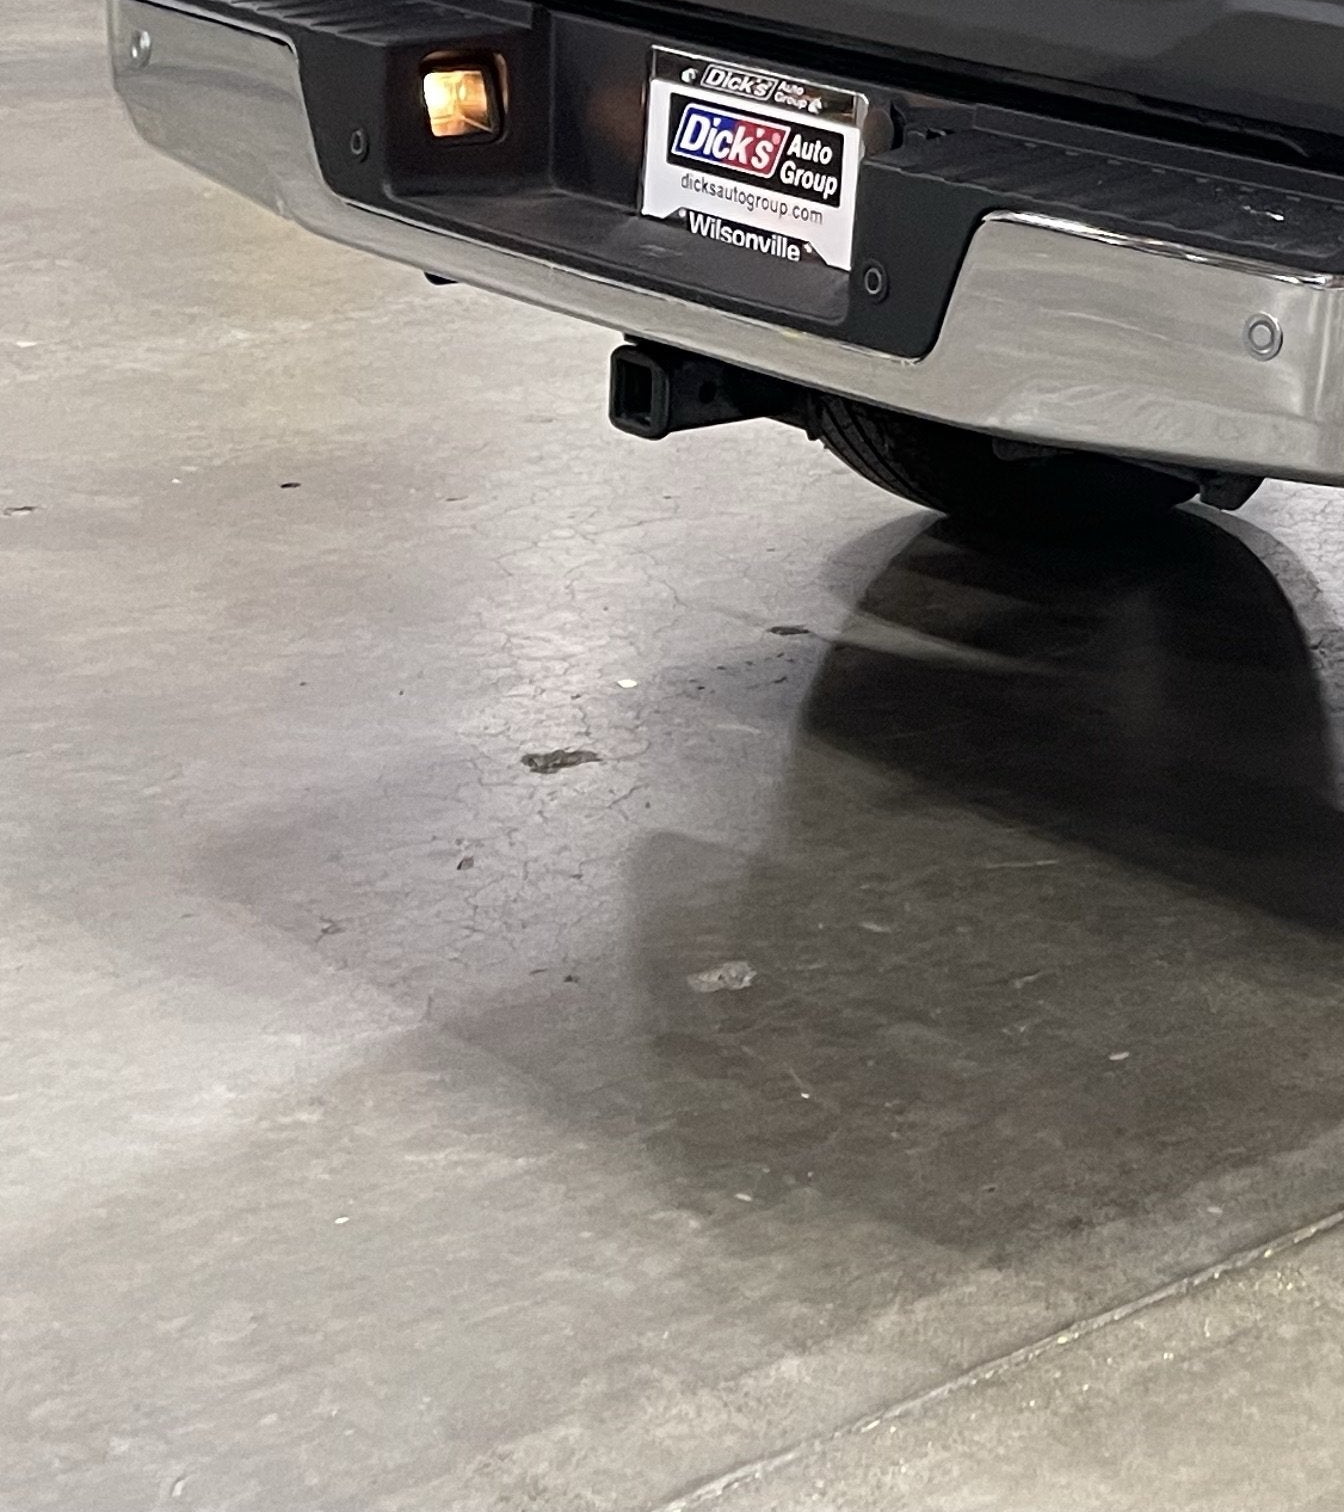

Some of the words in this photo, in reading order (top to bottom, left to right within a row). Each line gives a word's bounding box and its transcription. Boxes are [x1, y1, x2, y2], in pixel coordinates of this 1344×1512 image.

[705, 68, 774, 97] Dick's
[679, 112, 775, 170] Dick's
[786, 134, 833, 166] Auto
[681, 173, 824, 226] dicksautogroup.com
[779, 161, 839, 200] Group
[687, 211, 801, 263] Wilsonville
